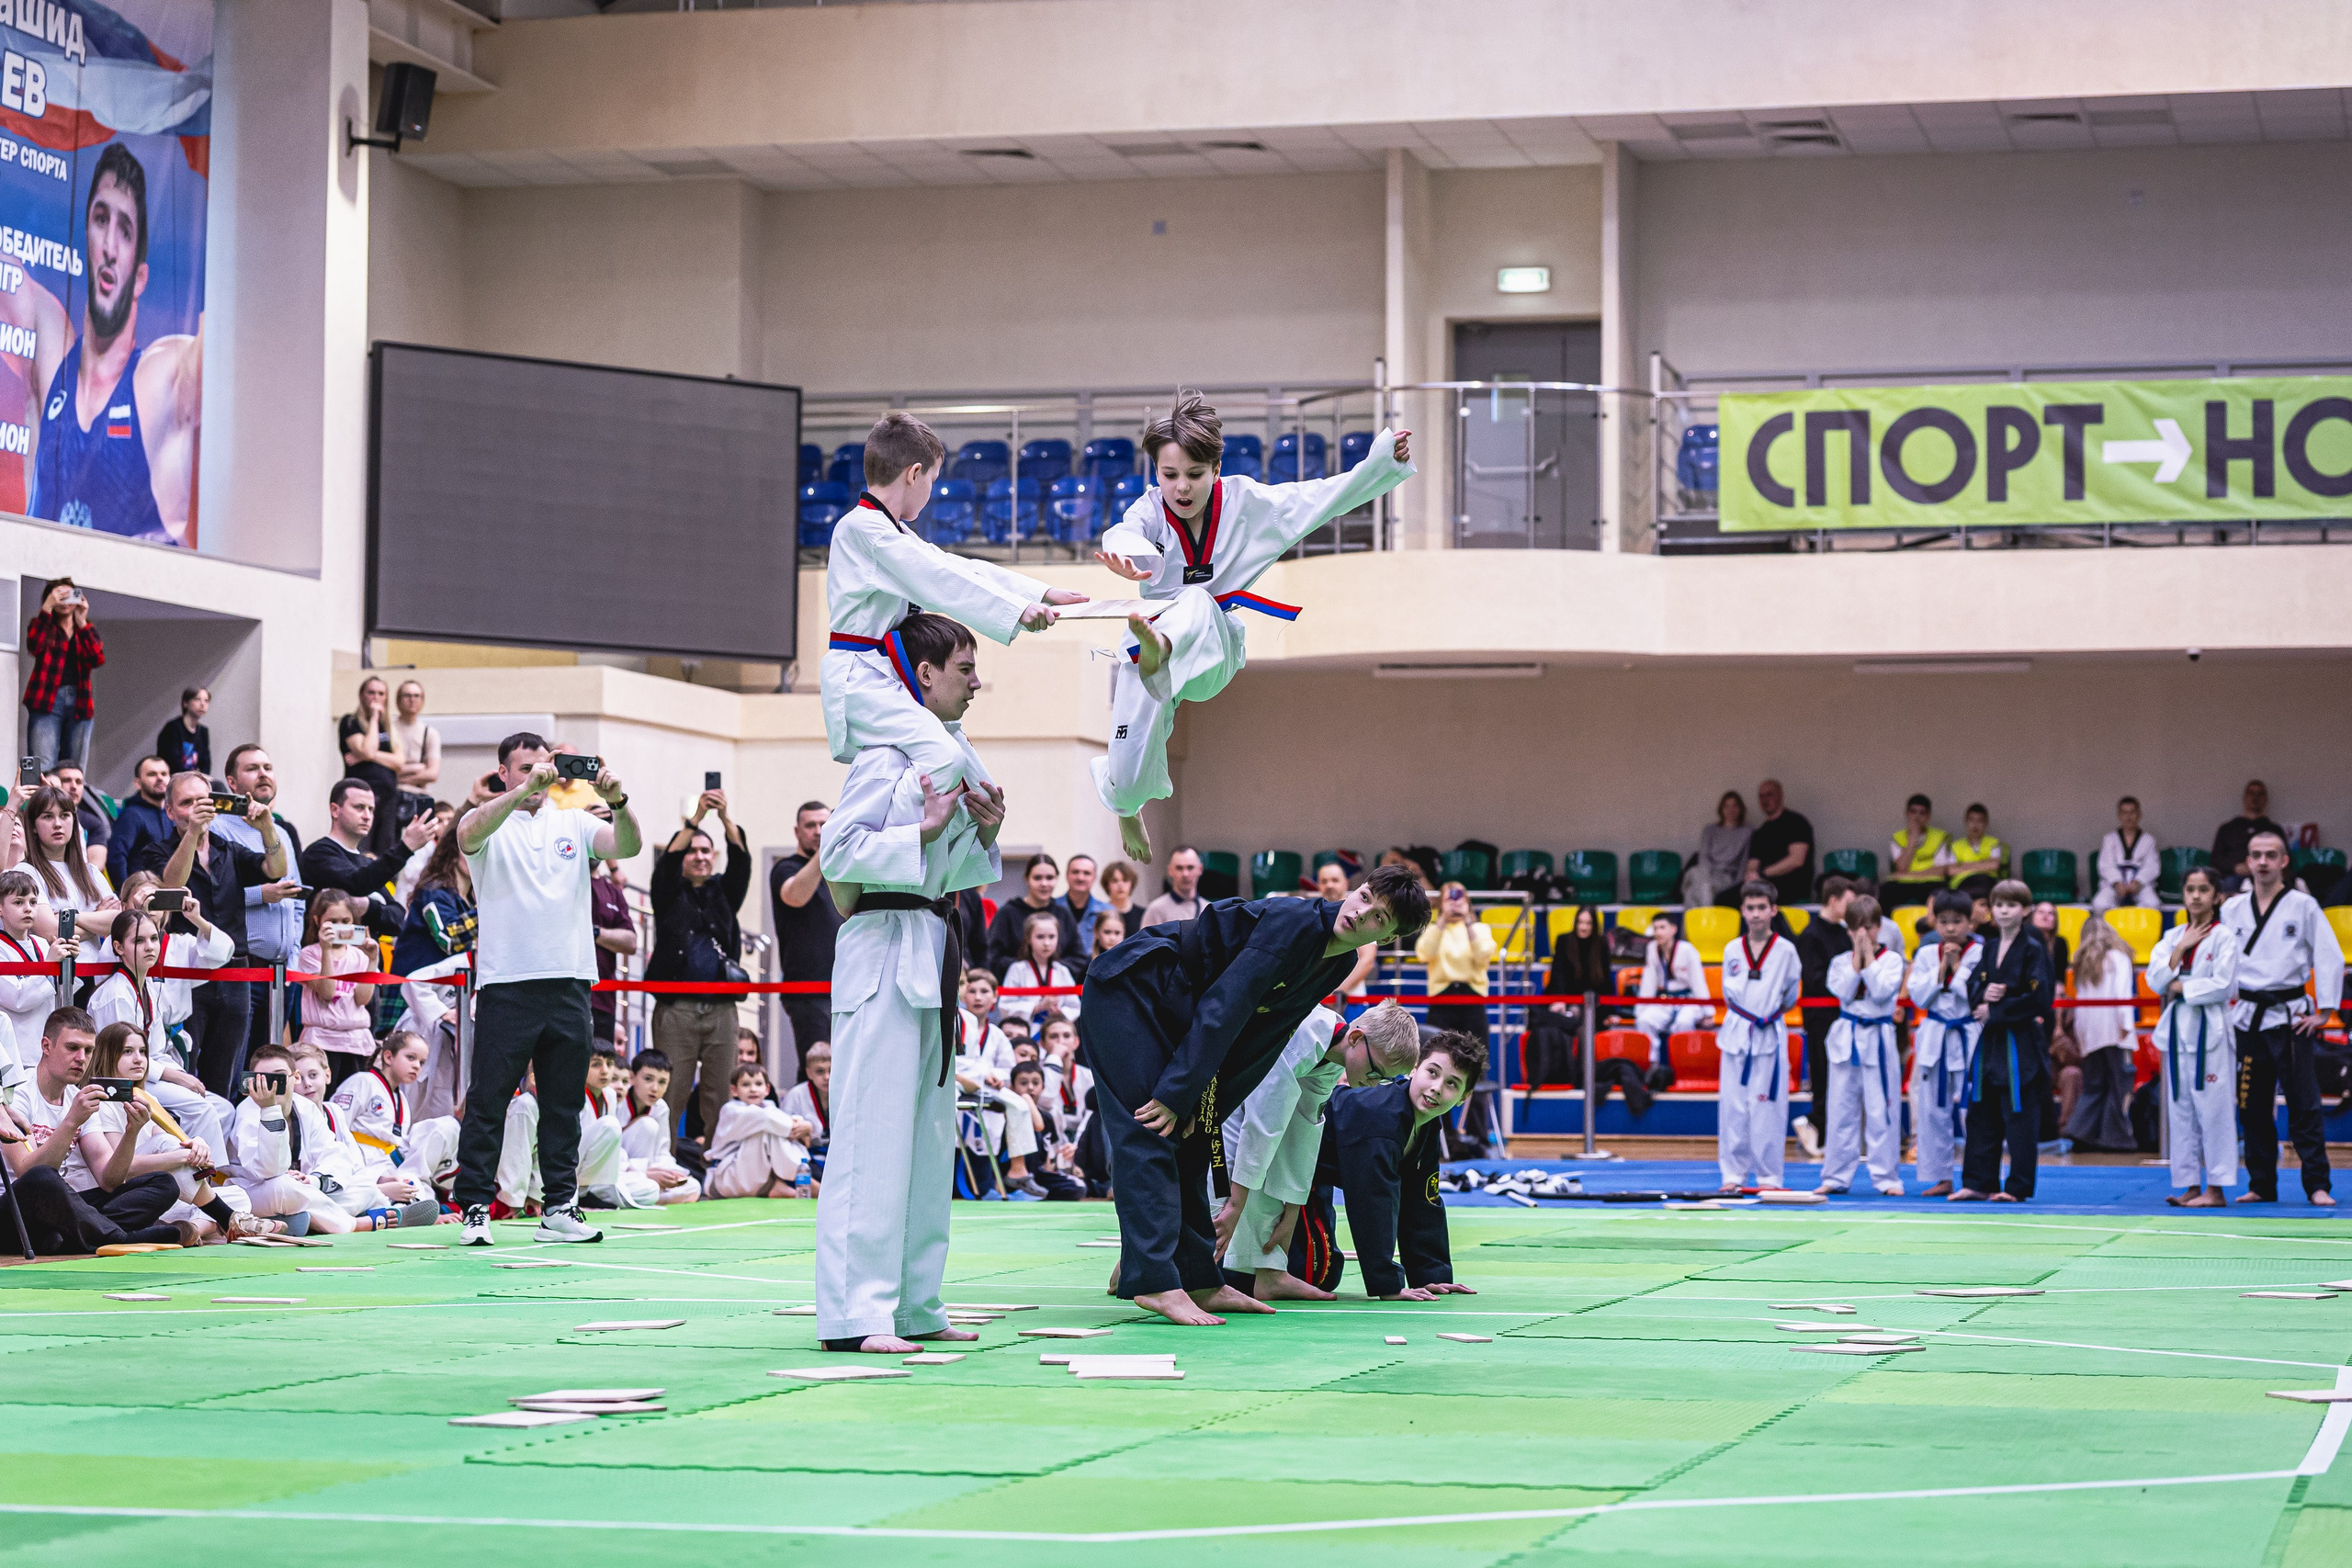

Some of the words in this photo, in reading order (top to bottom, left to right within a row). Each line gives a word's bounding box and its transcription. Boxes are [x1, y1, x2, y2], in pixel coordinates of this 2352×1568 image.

[2, 51, 46, 118] ЕВ
[0, 137, 18, 163] ЕР
[20, 145, 67, 182] СПОРТА
[0, 225, 83, 276] БЕДИТЕЛЬ
[0, 261, 23, 294] ГР
[0, 322, 37, 359] ИОН
[1747, 402, 2104, 508] СПОРТ
[2206, 396, 2352, 499] НО
[1204, 1074, 1218, 1134] AEKWONDO
